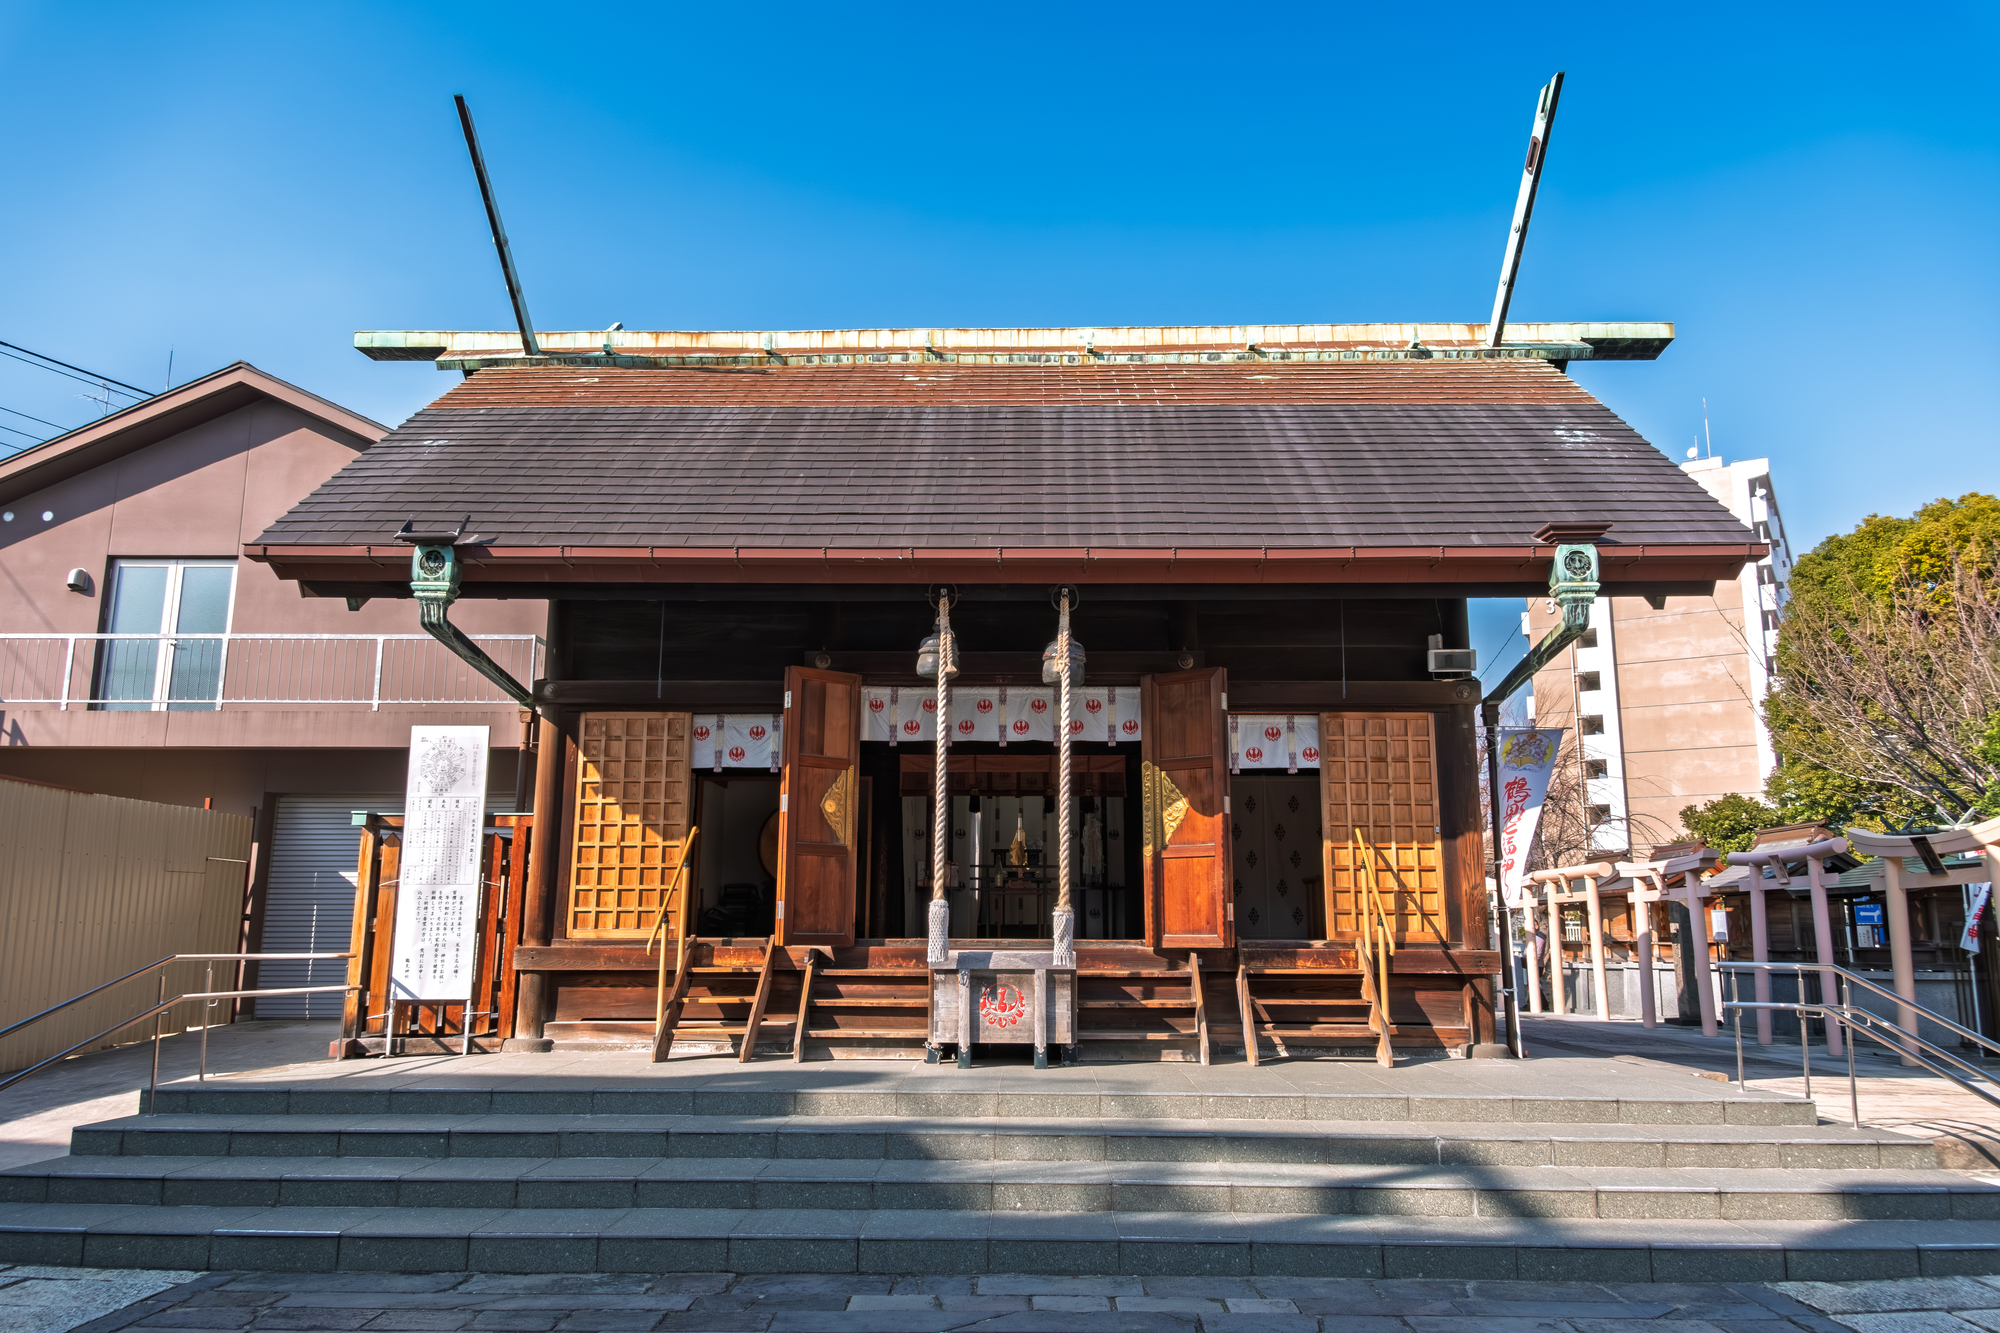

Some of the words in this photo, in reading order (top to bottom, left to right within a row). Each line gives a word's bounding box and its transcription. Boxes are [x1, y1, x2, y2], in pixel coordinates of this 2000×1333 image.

[1545, 599, 1555, 614] 3
[1501, 776, 1532, 900] 鶴見七福神
